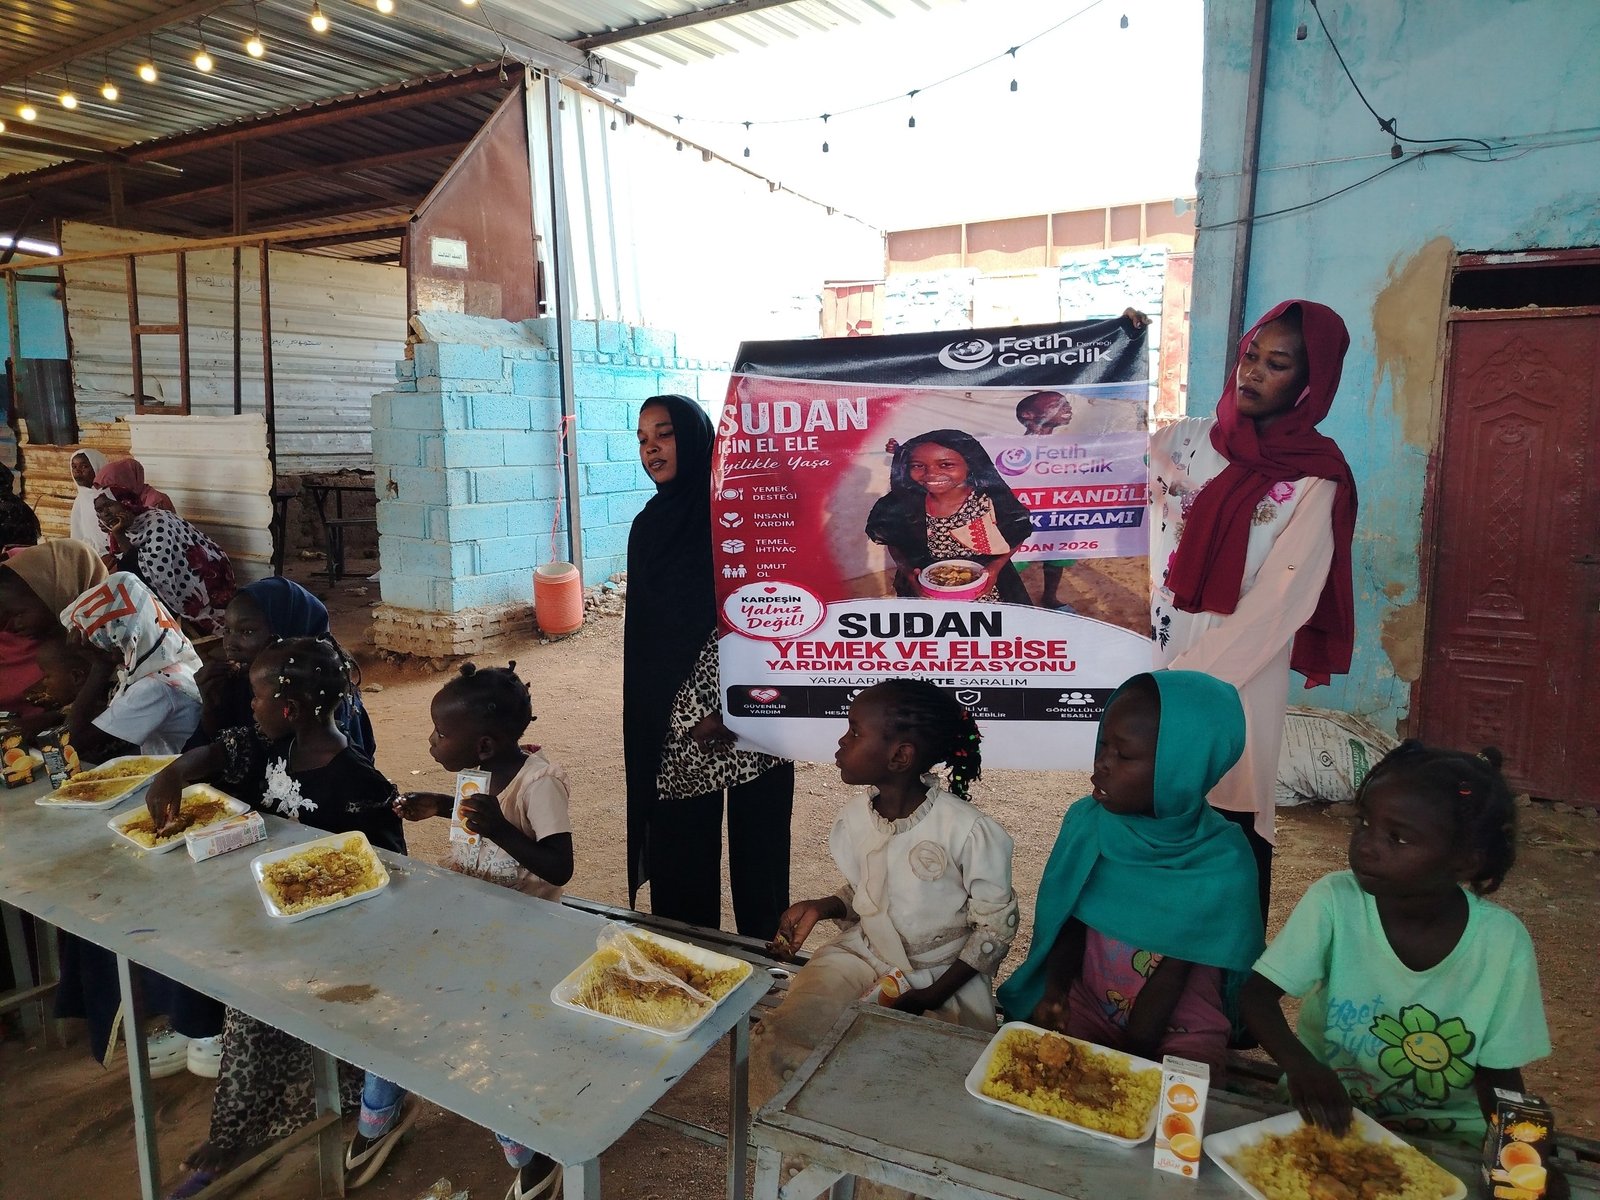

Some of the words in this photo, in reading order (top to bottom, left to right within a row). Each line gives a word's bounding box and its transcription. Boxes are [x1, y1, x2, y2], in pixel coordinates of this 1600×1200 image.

[999, 333, 1073, 352] Fetih
[998, 348, 1113, 367] Gençlik
[719, 397, 868, 437] SUDAN
[756, 438, 779, 453] EL
[785, 436, 819, 451] ELE
[1035, 443, 1087, 460] Fetih
[787, 456, 832, 470] Yaşa
[1035, 459, 1113, 475] Gençlik
[752, 493, 797, 501] DESTEĞİ
[753, 512, 790, 520] İNSANİ
[1048, 511, 1135, 527] İKRAMI
[755, 545, 797, 554] İHTİYAÇ
[1058, 541, 1099, 551] 2026
[741, 595, 801, 604] KARDEŞİN
[741, 604, 802, 617] Yalnız
[746, 614, 804, 632] Değil!
[838, 611, 1003, 639] SUDAN
[772, 641, 887, 659] YEMEK
[895, 641, 939, 659] VE
[949, 636, 1068, 659] ELBİSE
[766, 660, 853, 671] YARDIM
[857, 658, 1076, 672] ORGANİZASYONU
[959, 678, 1028, 686] SARALIM
